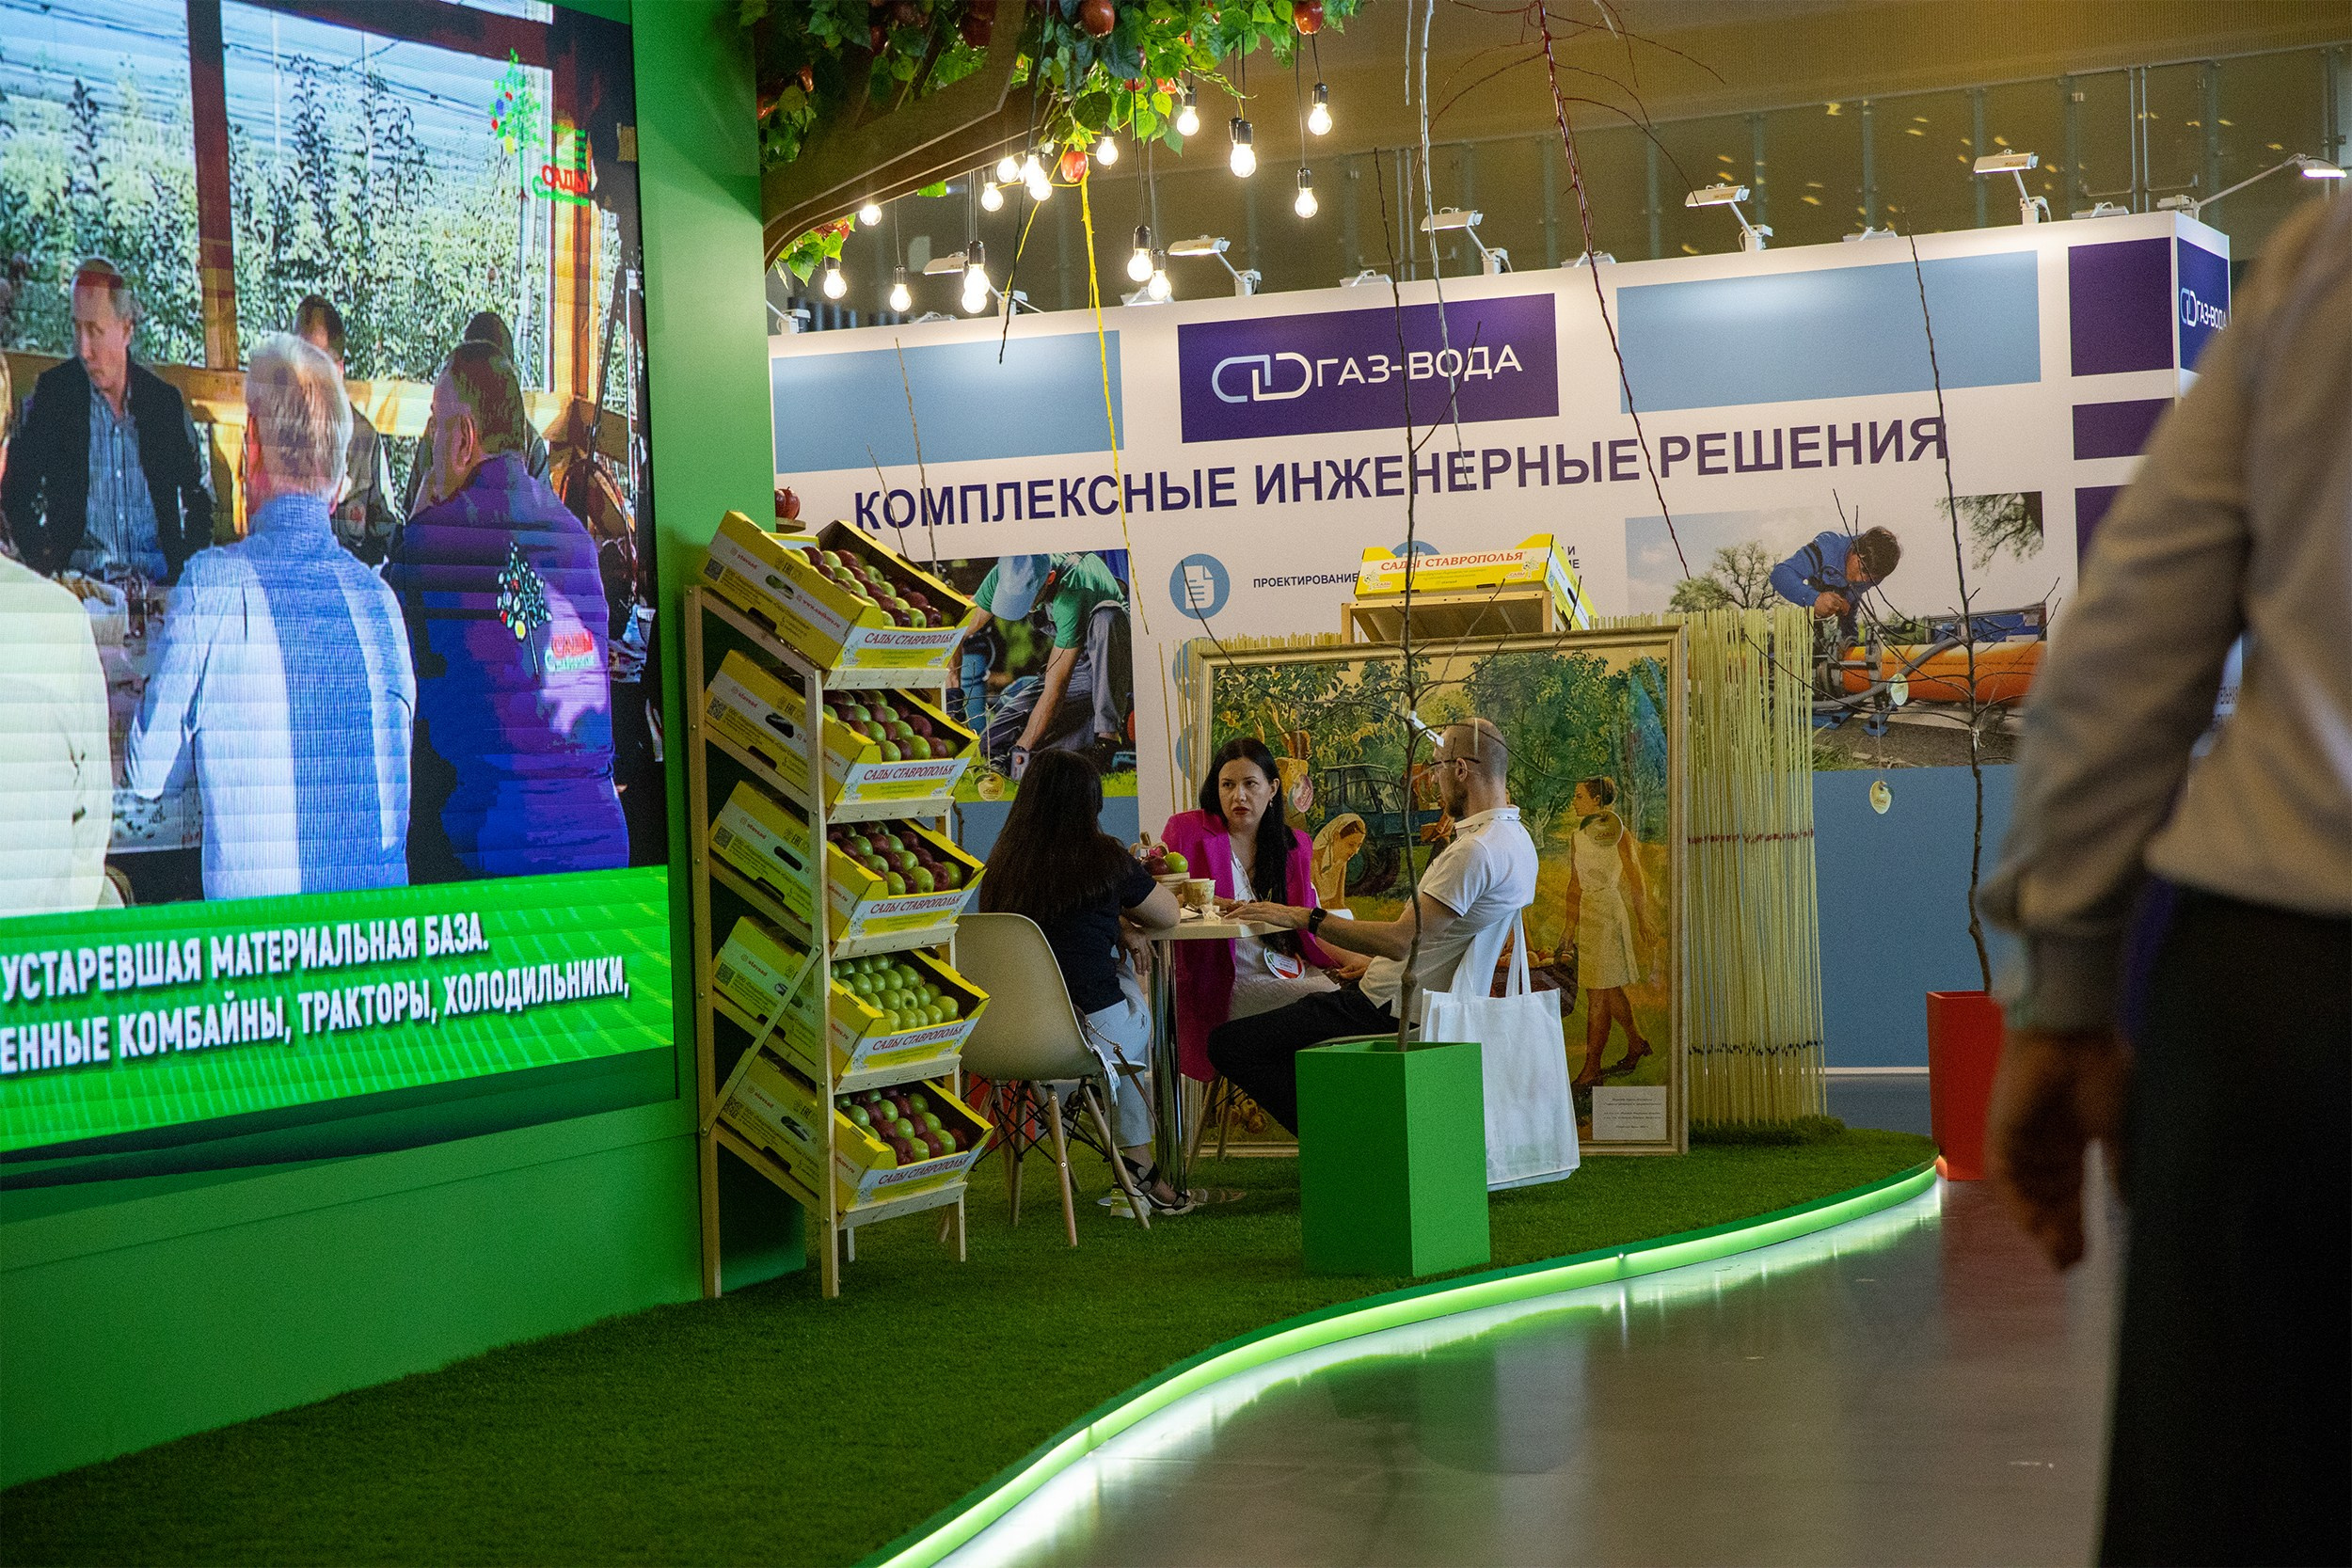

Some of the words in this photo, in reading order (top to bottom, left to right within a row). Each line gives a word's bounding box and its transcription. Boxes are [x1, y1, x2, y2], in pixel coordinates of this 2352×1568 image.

[1317, 344, 1522, 387] ГАЗ-ВОДА
[854, 466, 1238, 530] КОМПЛЕКСНЫЕ
[1254, 437, 1641, 505] ИНЖЕНЕРНЫЕ
[1659, 416, 1947, 479] РЕШЕНИЯ
[1425, 551, 1523, 567] СТАВРОПОЛЬЯ
[1253, 573, 1359, 588] ПРОЕКТИРОВАНИЕ
[864, 632, 896, 644] САДЫ
[895, 632, 956, 646] СТАВРОПОЛЬЯ
[863, 769, 892, 782] САДЫ
[893, 765, 955, 780] СТАВРОПОЛЬЯ
[870, 901, 899, 914] САДЫ
[899, 895, 961, 911] СТАВРОПОЛЬЯ
[1, 937, 202, 1003] УСТАРЕВШАЯ
[211, 918, 418, 979] МАТЕРИАЛЬНАЯ
[424, 911, 489, 956] БАЗА.
[0, 1016, 110, 1074] ЕННЫЕ
[119, 990, 292, 1058] КОМБАЙНЫ,
[298, 979, 437, 1035] ТРАКТОРЫ,
[443, 956, 629, 1016] ХОЛОДИЛЬНИКИ,
[872, 1037, 903, 1051] САДЫ
[902, 1025, 965, 1046] СТАВРОПОЛЬЯ
[879, 1171, 909, 1185] САДЫ
[908, 1156, 970, 1179] СТАВРОПОЛЬЯ
